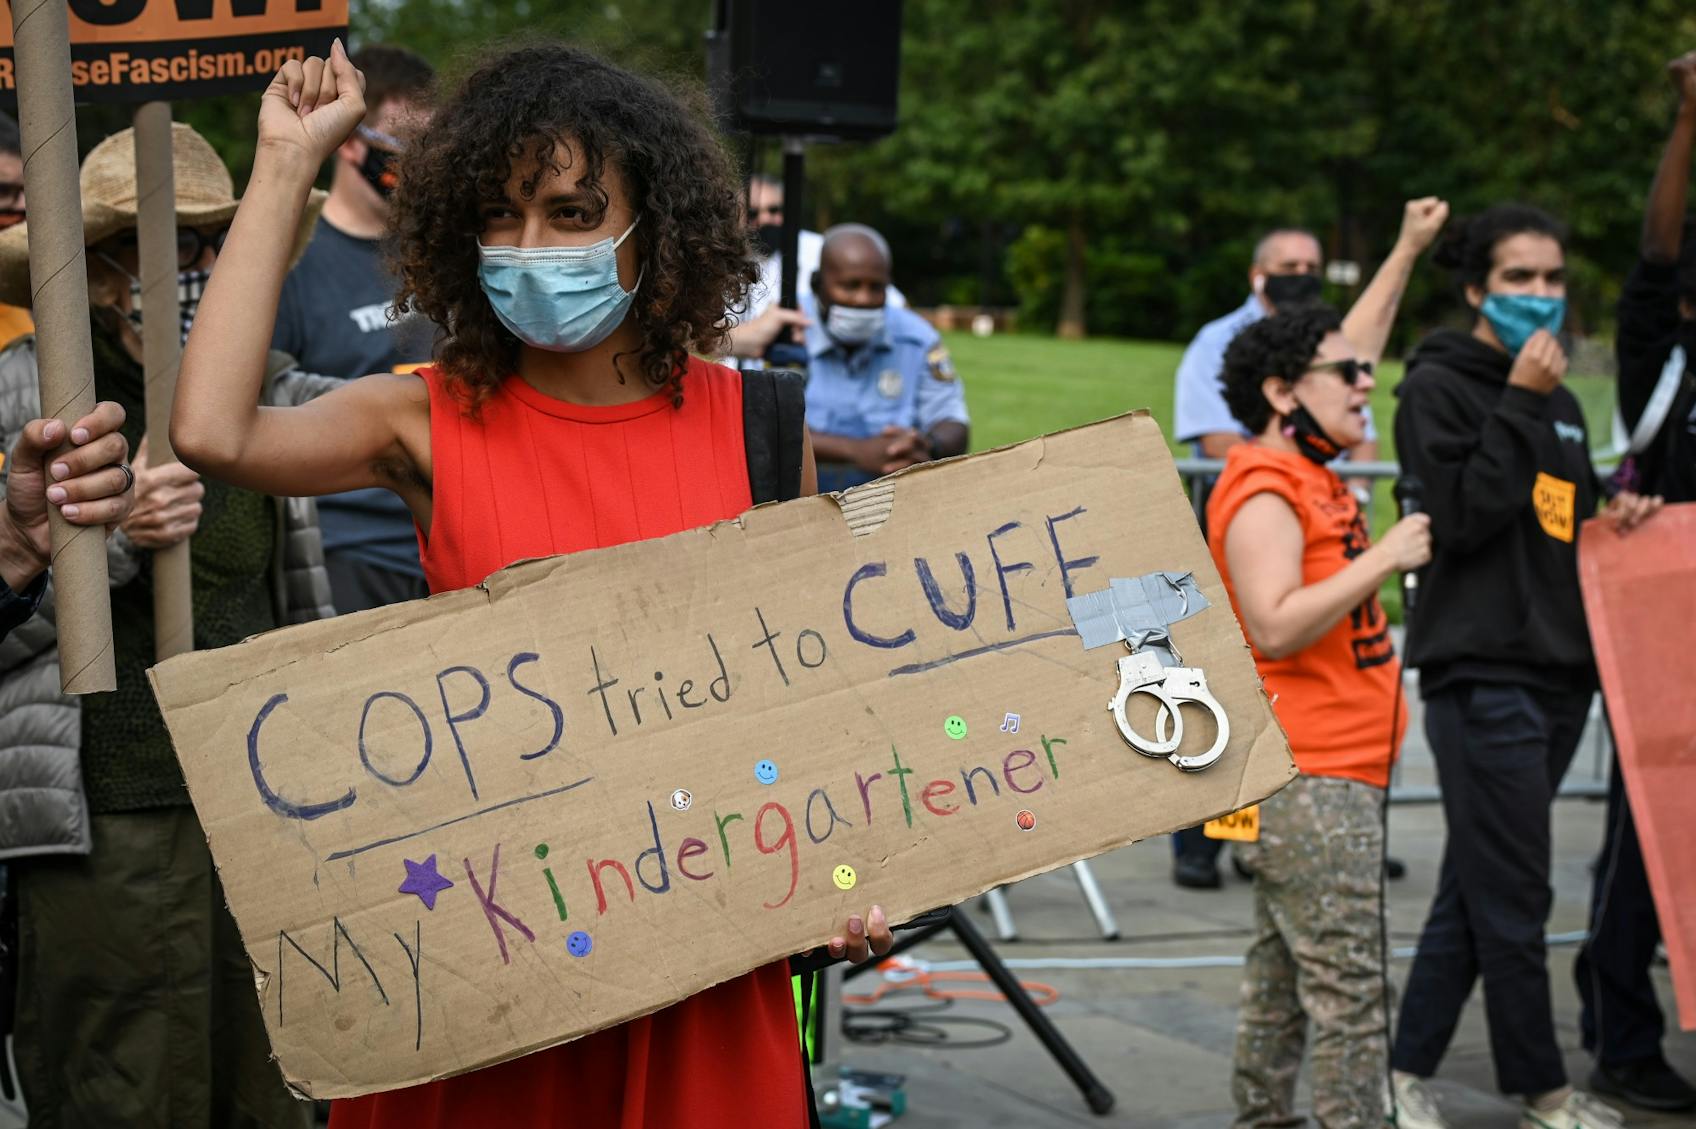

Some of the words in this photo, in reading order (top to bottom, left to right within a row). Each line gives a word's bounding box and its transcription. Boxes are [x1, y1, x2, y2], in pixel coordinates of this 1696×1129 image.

[247, 652, 564, 821] COPS
[586, 634, 732, 736] tried
[751, 606, 827, 687] to
[842, 505, 1100, 650] CUFF
[463, 733, 1068, 964] Kindergartener
